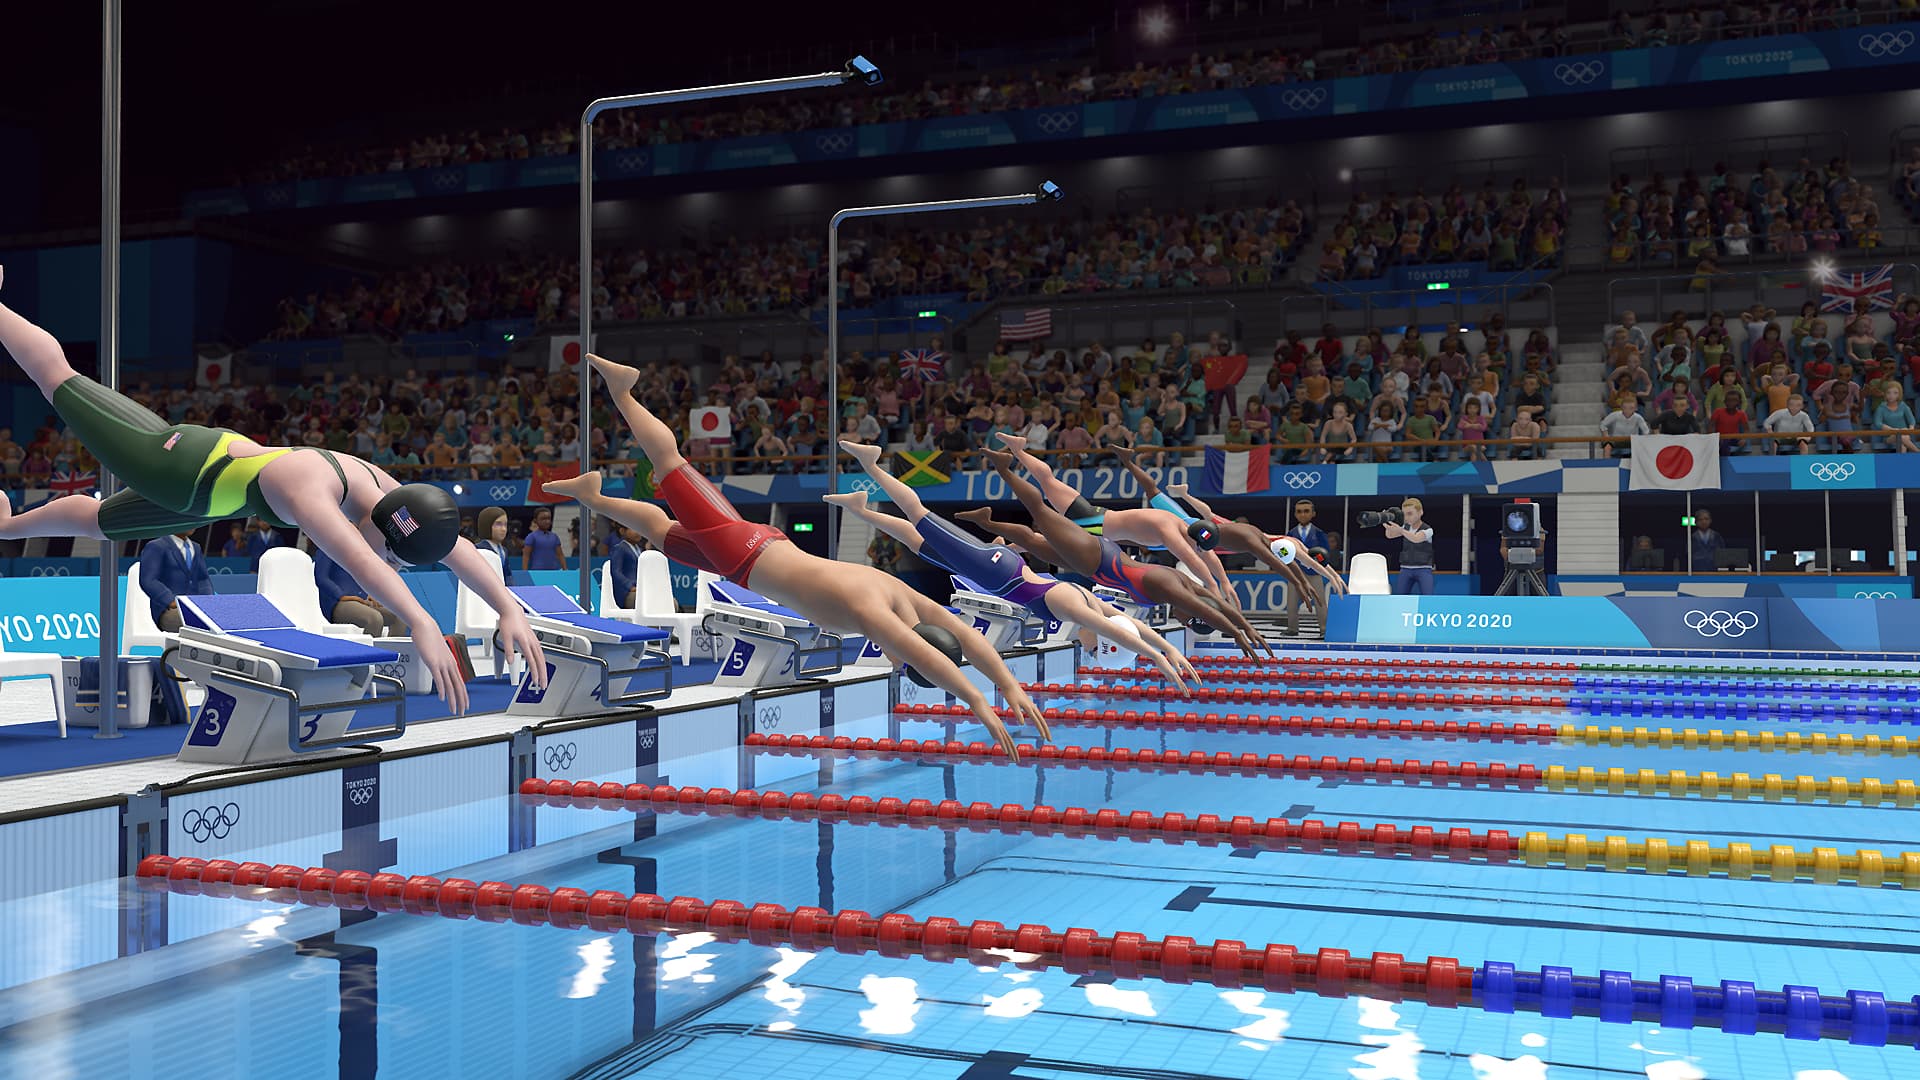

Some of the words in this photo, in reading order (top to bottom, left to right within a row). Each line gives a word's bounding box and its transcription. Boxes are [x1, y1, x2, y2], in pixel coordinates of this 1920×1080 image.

[1726, 53, 1763, 65] TOKYO
[1765, 50, 1793, 62] 2020
[962, 469, 1083, 500] TOO
[36, 612, 100, 641] 2020
[1402, 612, 1462, 628] TOKYO
[1466, 613, 1512, 628] 2020
[732, 652, 744, 670] 5
[205, 708, 221, 736] 3
